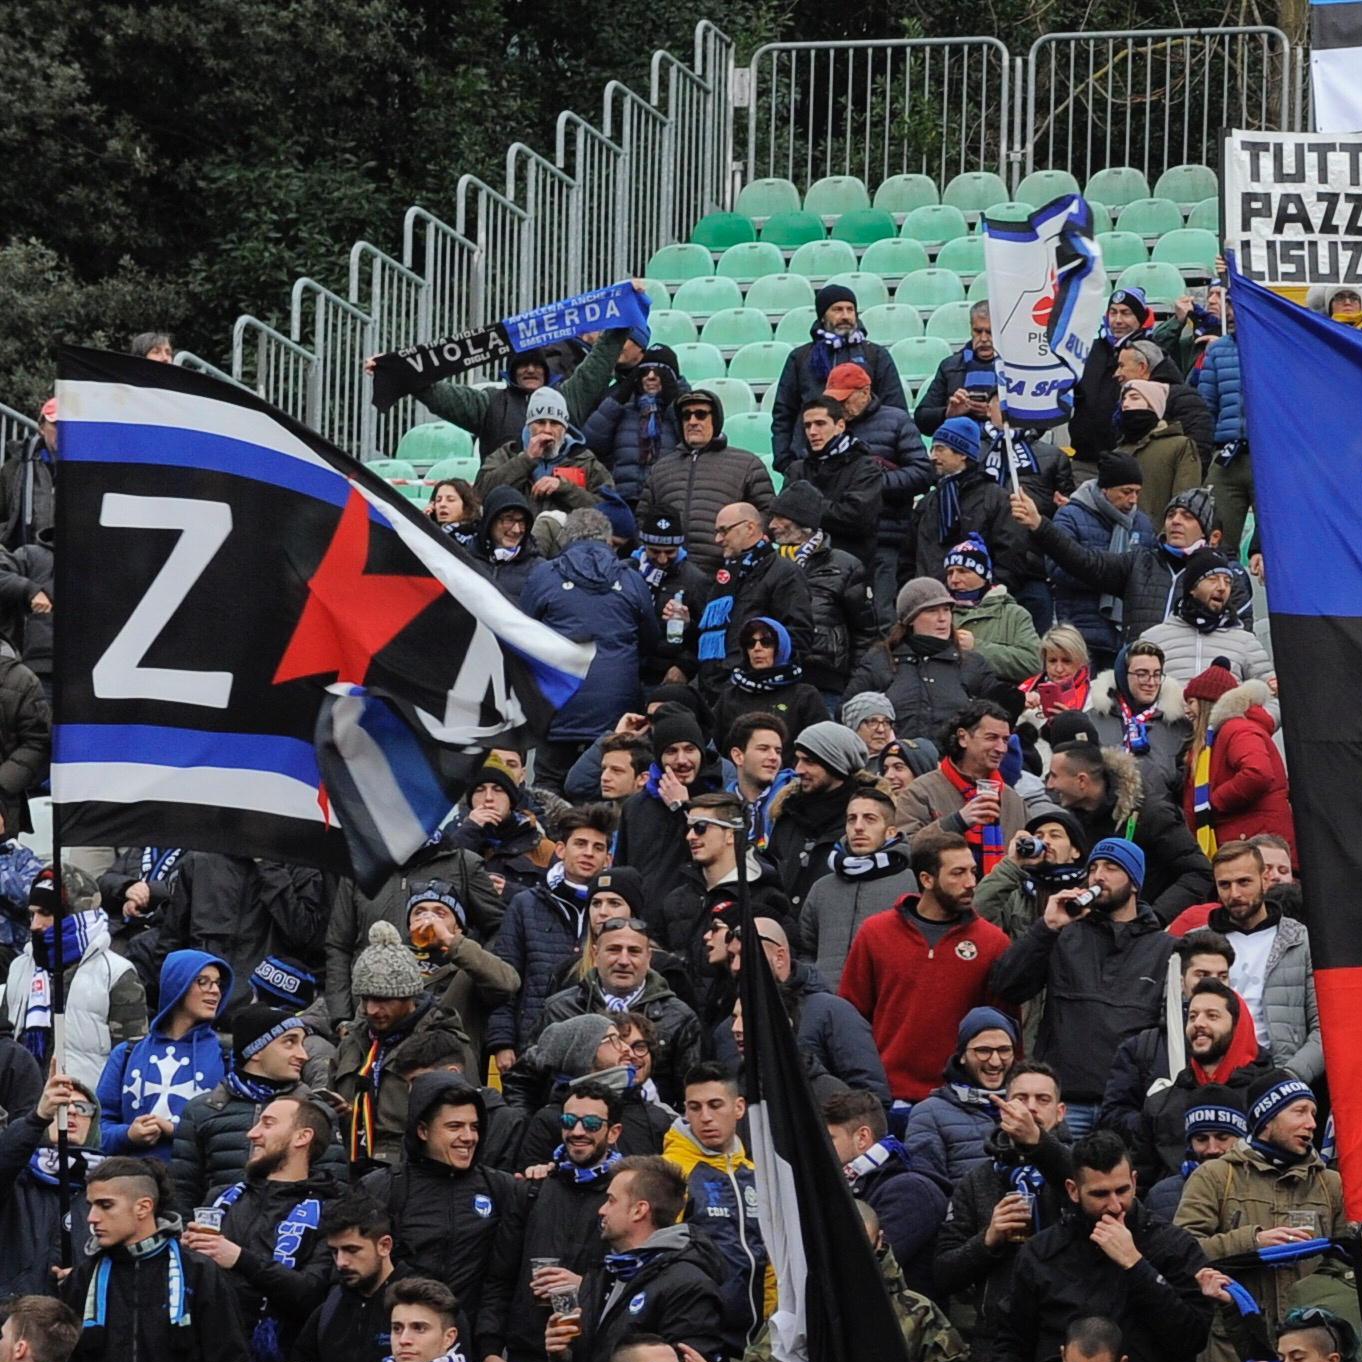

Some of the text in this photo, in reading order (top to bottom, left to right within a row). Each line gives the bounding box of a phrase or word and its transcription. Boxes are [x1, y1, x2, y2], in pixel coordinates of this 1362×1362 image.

[406, 300, 622, 374] VIOLA MERDA
[92, 492, 234, 709] Z
[1188, 1110, 1216, 1124] NON
[1217, 1110, 1231, 1123] SI
[1253, 1091, 1281, 1119] PISA
